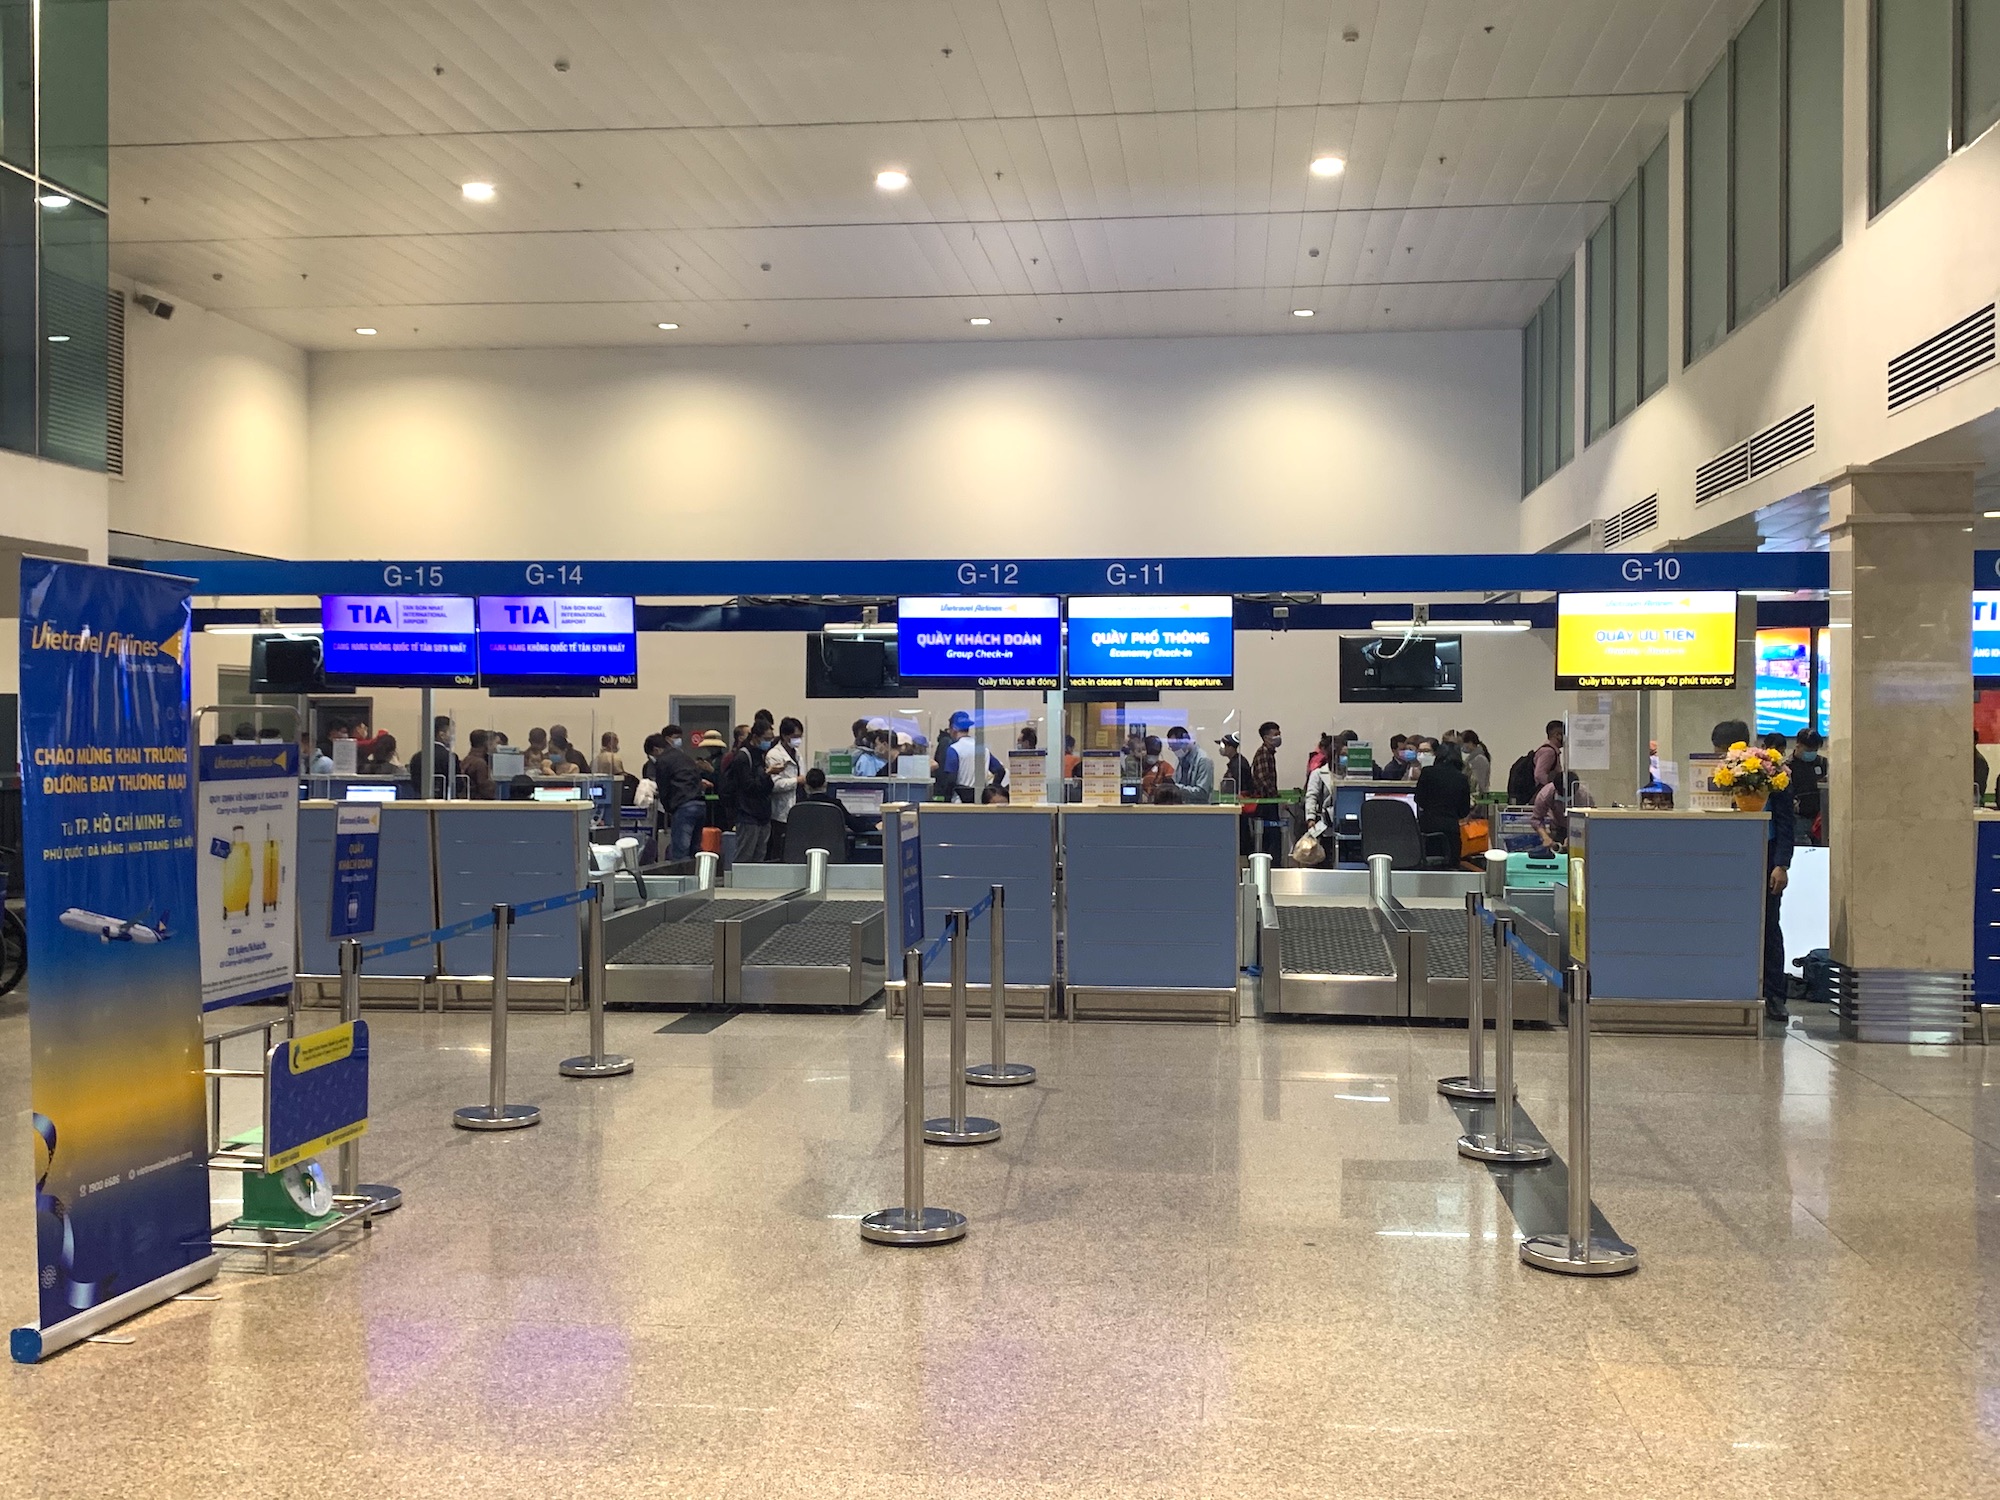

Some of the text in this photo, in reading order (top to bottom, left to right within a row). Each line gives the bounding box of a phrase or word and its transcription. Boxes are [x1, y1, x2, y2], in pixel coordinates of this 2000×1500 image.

[383, 565, 444, 587] G-15
[525, 563, 584, 586] G-14
[957, 562, 1019, 585] G-12
[1106, 563, 1165, 586] G-11
[1621, 558, 1681, 581] G-10
[347, 604, 393, 624] TIA
[503, 605, 550, 624] TIA
[941, 604, 1003, 613] Vietravel Airlines
[31, 621, 159, 658] Vietravel Airlines
[917, 630, 1042, 648] QUẦY KHÁCH ĐOÀN
[1162, 629, 1210, 645] THÔNG
[946, 649, 1013, 660] Group Check-in
[1109, 648, 1193, 659] Economy Check-in
[600, 675, 618, 686] Quầy
[978, 677, 1057, 687] Quầy thủ tục sẽ đóng
[1096, 678, 1122, 686] closes
[1123, 678, 1133, 686] 40
[1134, 678, 1154, 686] mins
[1155, 678, 1173, 687] prior
[1174, 678, 1183, 686] to
[1184, 678, 1223, 687] departure.
[1579, 677, 1600, 687] Quầy
[1601, 676, 1615, 686] thủ
[1616, 677, 1630, 687] tục
[1643, 677, 1666, 687] đóng
[1667, 677, 1678, 685] 40
[1679, 676, 1699, 687] phút
[1700, 677, 1723, 685] trước
[34, 744, 187, 766] CHÀO MỪNG KHAI TRƯƠNG
[43, 772, 187, 795] ĐƯỜNG BAY THƯƠNG MẠI
[75, 818, 91, 835] TP.
[93, 812, 112, 833] HỒ
[115, 812, 133, 833] CHÍ
[135, 814, 165, 830] MINH
[43, 845, 62, 861] PHÚ
[128, 841, 142, 853] NHA
[144, 840, 169, 852] TRANG
[88, 1179, 104, 1194] 1900
